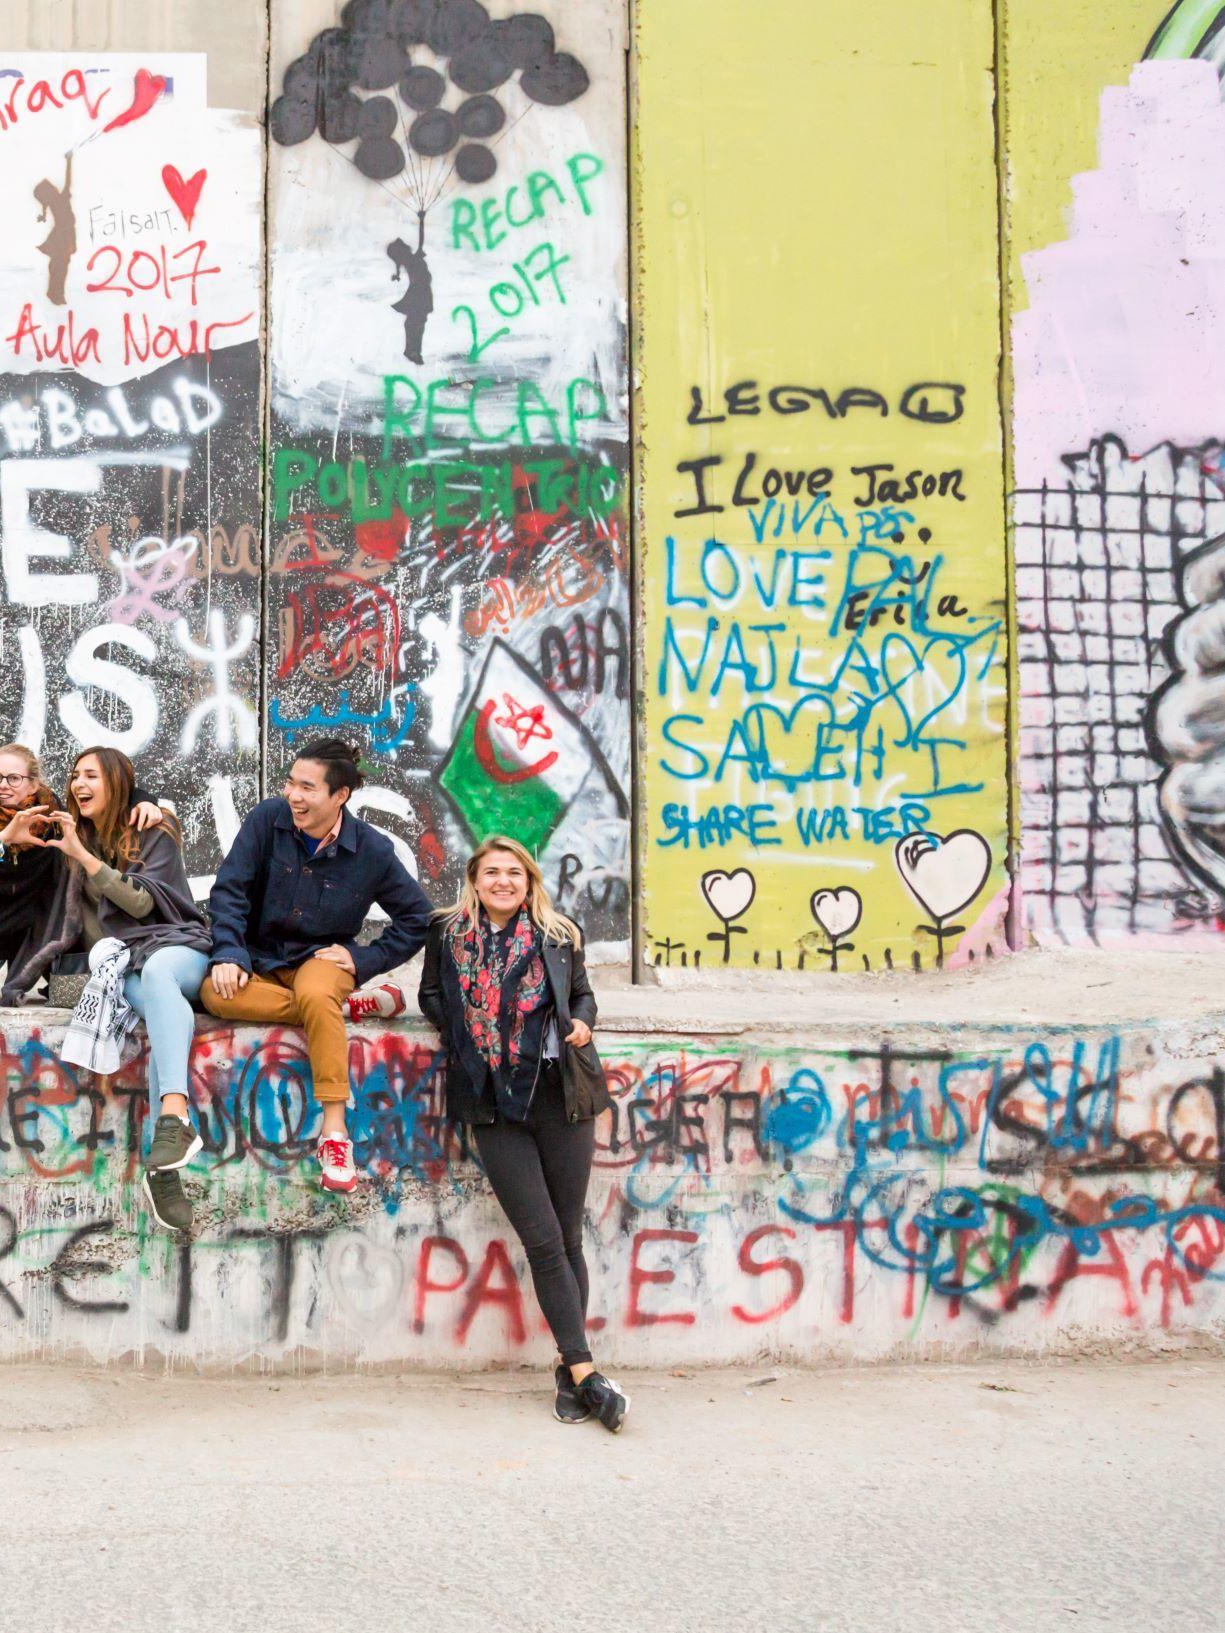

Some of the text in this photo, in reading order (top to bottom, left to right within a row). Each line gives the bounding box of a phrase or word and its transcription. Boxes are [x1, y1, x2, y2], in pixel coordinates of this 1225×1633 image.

[449, 152, 603, 252] RECAP
[86, 240, 222, 306] 2017
[451, 242, 571, 364] 2017
[6, 303, 255, 367] Aula Nour
[383, 374, 608, 460] RECAP
[673, 454, 725, 518] I
[849, 463, 966, 508] Jason
[746, 492, 850, 544] VIVA
[664, 535, 834, 610] LOVE
[656, 800, 940, 852] SHARE WATER
